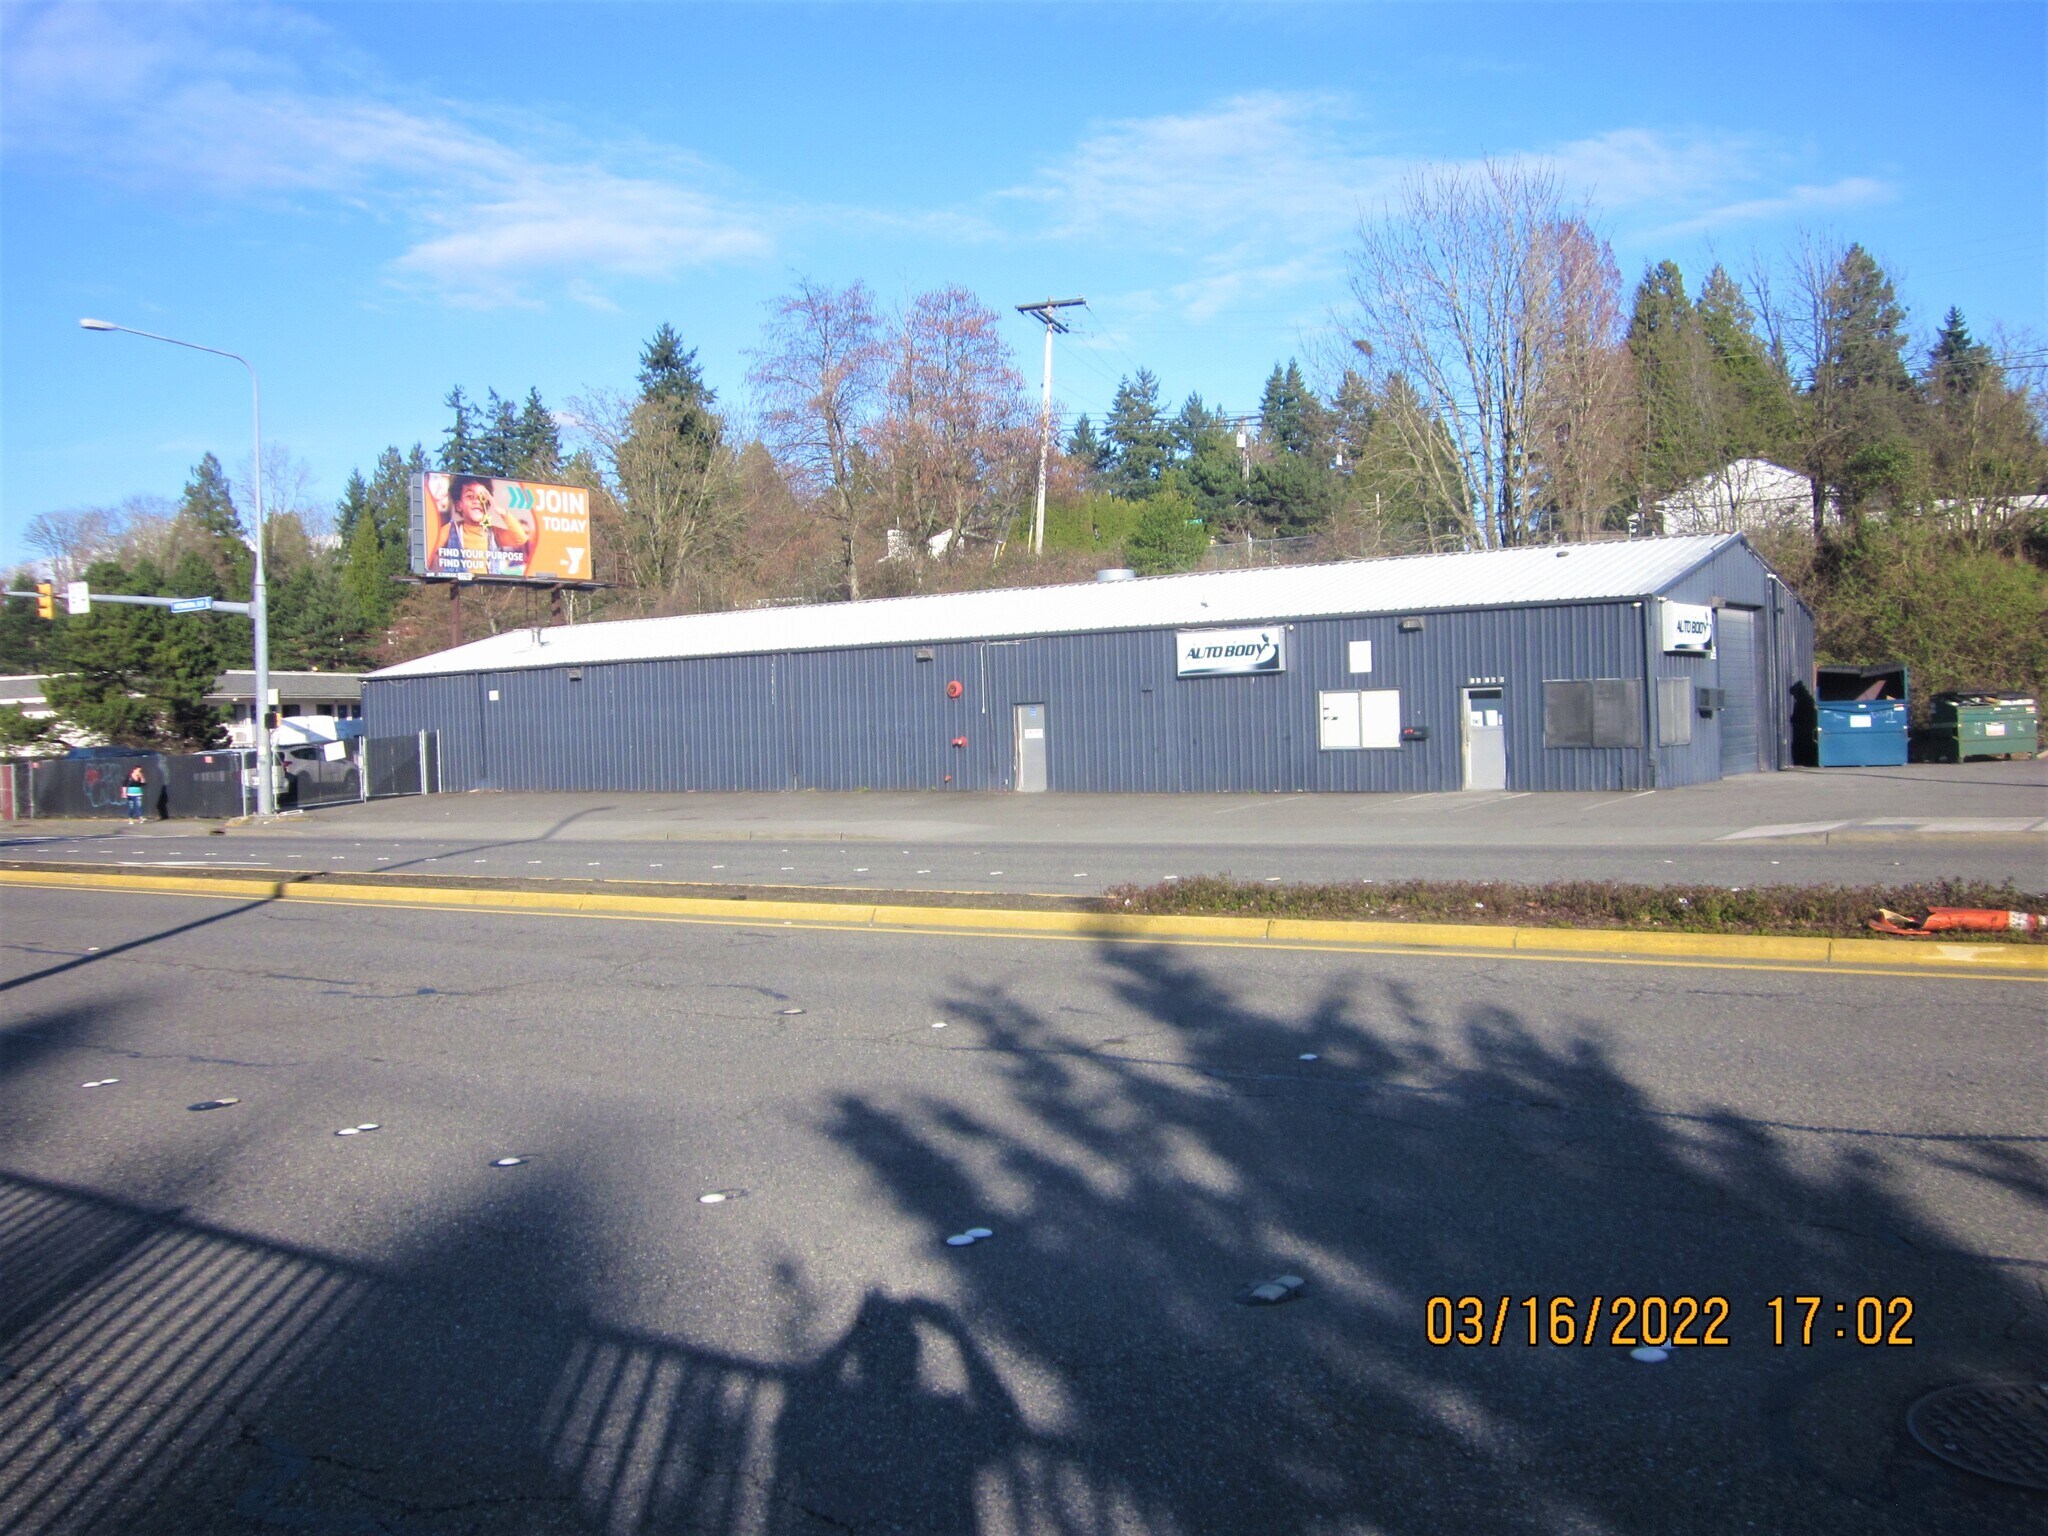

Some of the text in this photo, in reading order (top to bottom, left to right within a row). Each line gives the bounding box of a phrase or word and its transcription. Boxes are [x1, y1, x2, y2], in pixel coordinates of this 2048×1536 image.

[535, 488, 585, 515] JOIN
[542, 516, 587, 533] TODAY
[438, 547, 524, 561] FIND YOUR PURPOSE
[438, 558, 460, 568] FIND
[461, 560, 485, 569] YOUR
[1677, 619, 1709, 638] AUTO BODY
[1186, 643, 1269, 661] AUTO BODY
